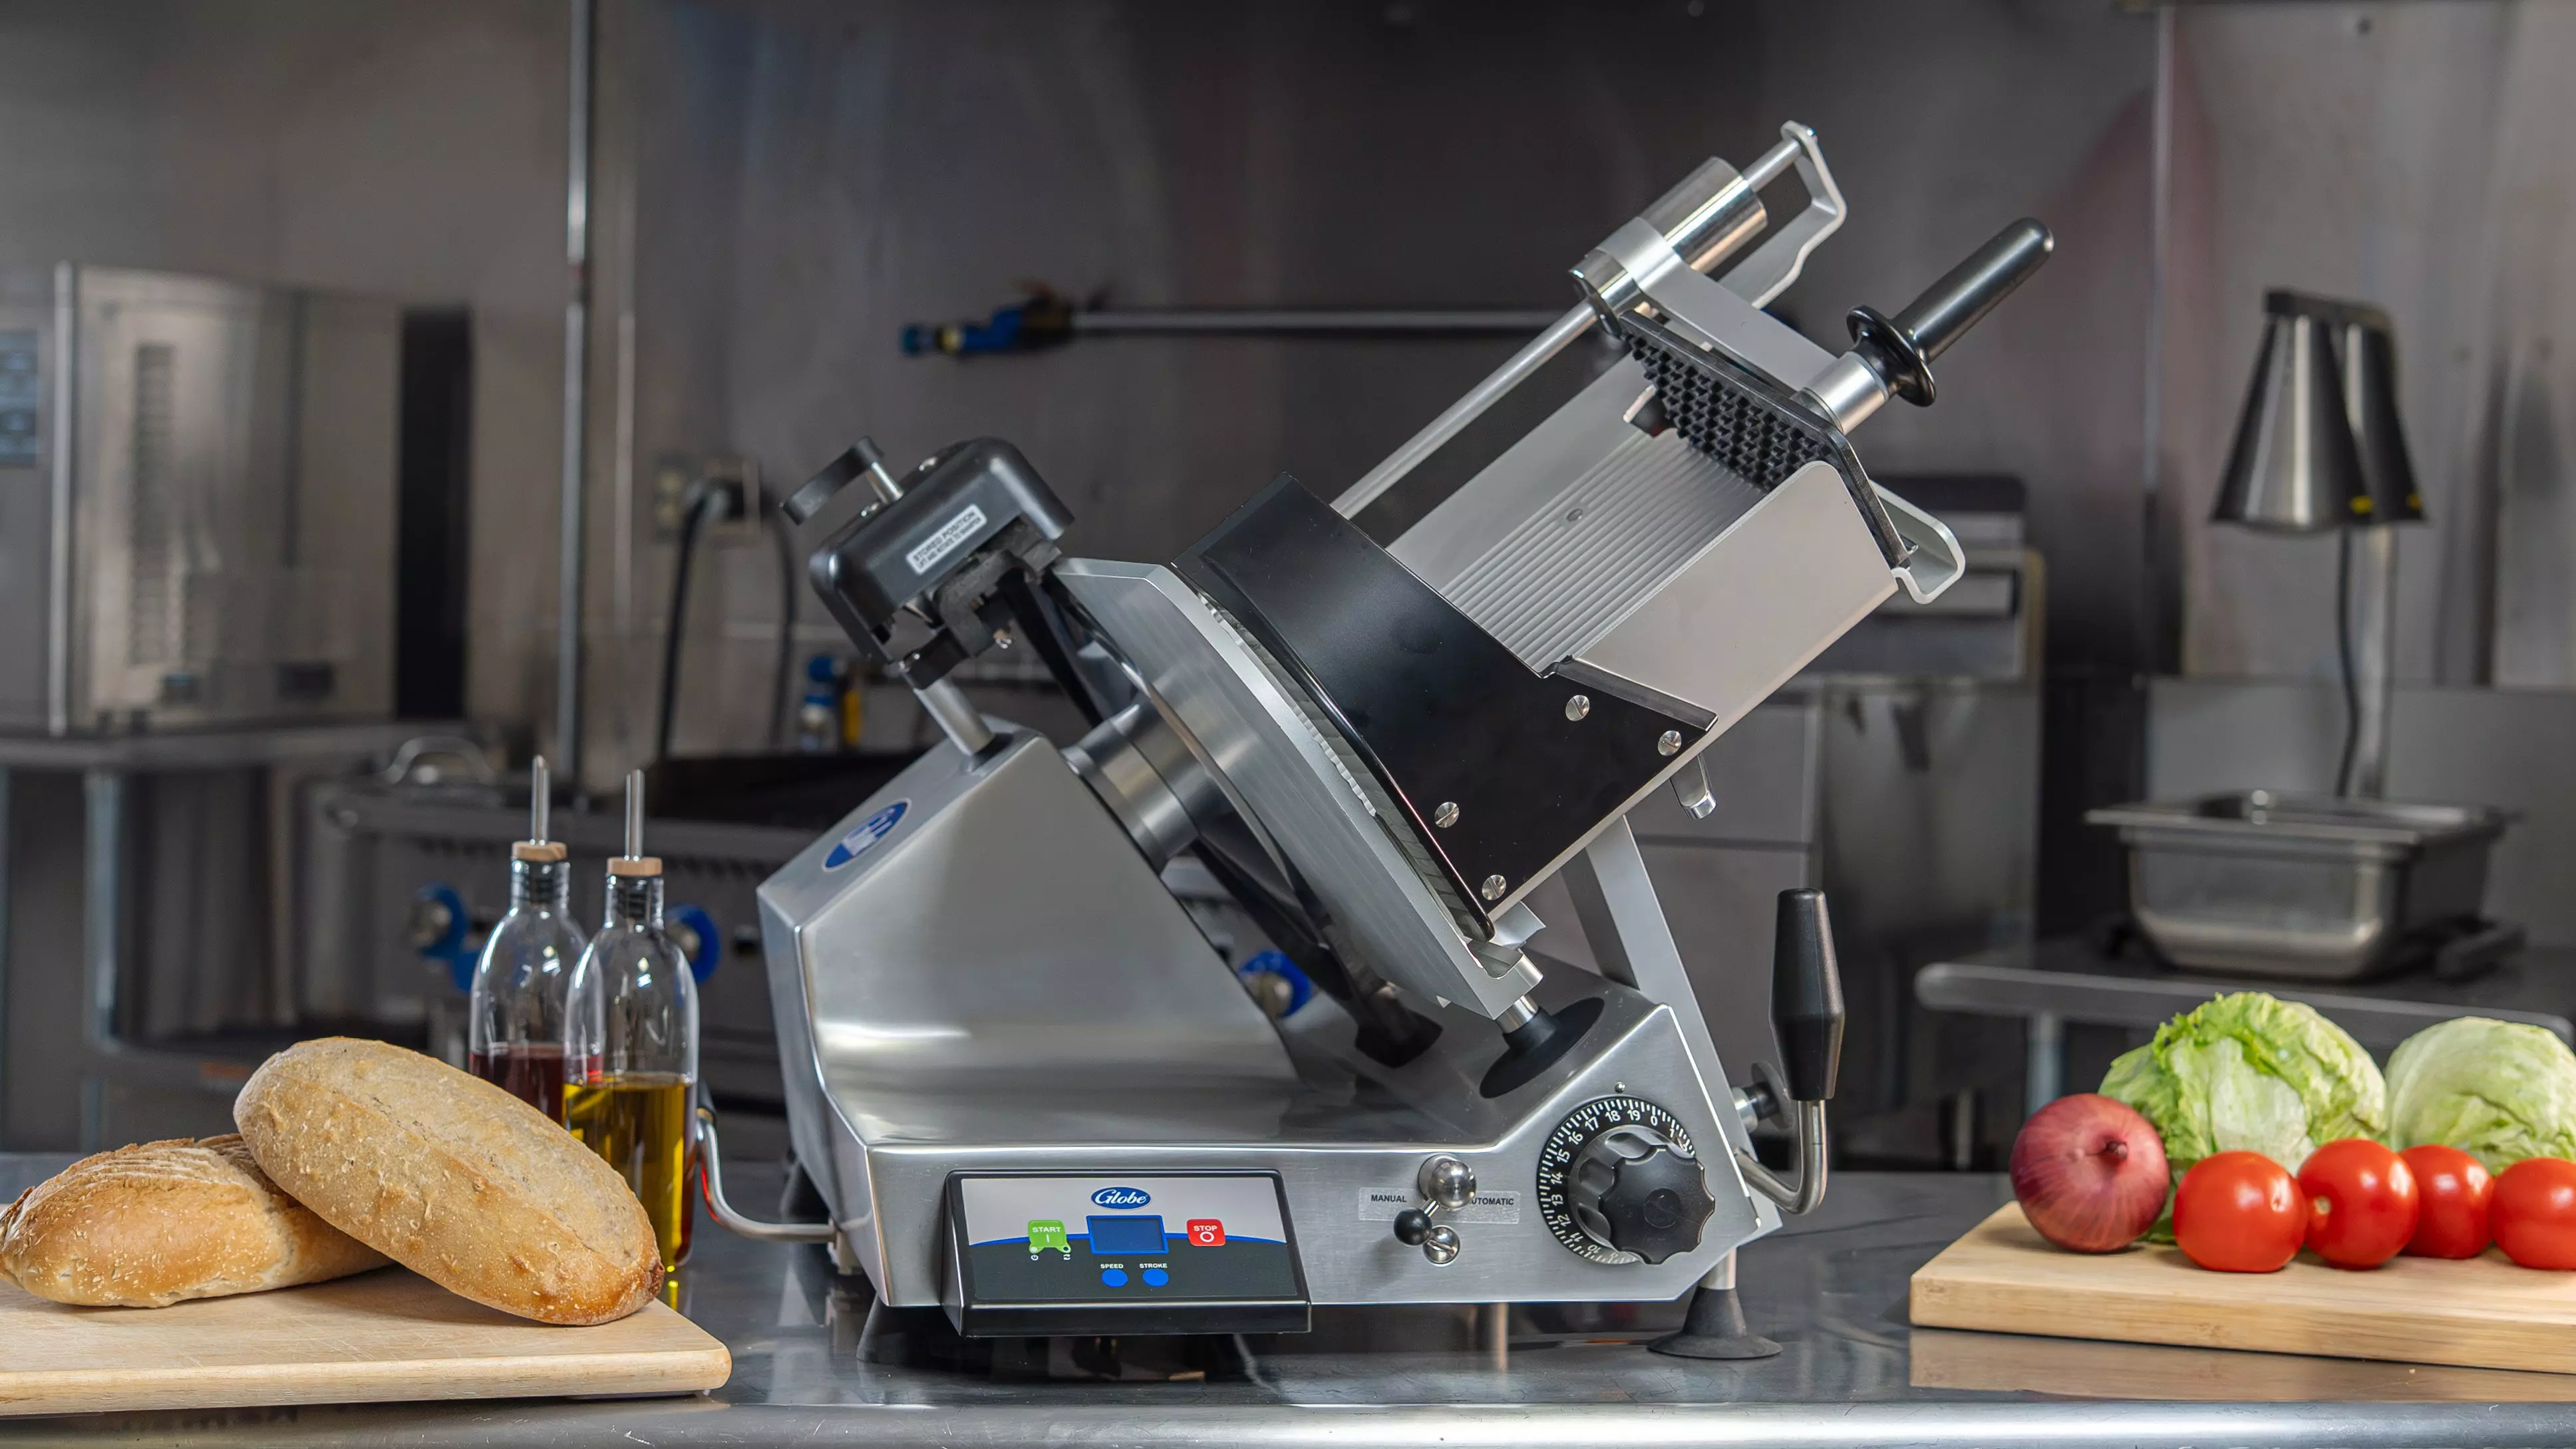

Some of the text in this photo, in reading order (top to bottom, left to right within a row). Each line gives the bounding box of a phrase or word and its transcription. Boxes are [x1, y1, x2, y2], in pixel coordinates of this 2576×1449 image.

[913, 511, 975, 561] STORED POSITION
[1605, 1110, 1621, 1122] 18
[1627, 1109, 1641, 1121] 19
[1650, 1115, 1658, 1126] 0
[1585, 1116, 1599, 1131] 17
[1568, 1131, 1583, 1145] 16
[1556, 1148, 1570, 1163] 15
[1551, 1172, 1563, 1184] 14
[1094, 1189, 1147, 1204] Globe
[1370, 1194, 1407, 1203] MANUAL
[1551, 1194, 1563, 1206] 13
[1557, 1213, 1571, 1227] 12
[1570, 1232, 1583, 1243] 11
[1587, 1244, 1601, 1253] 10
